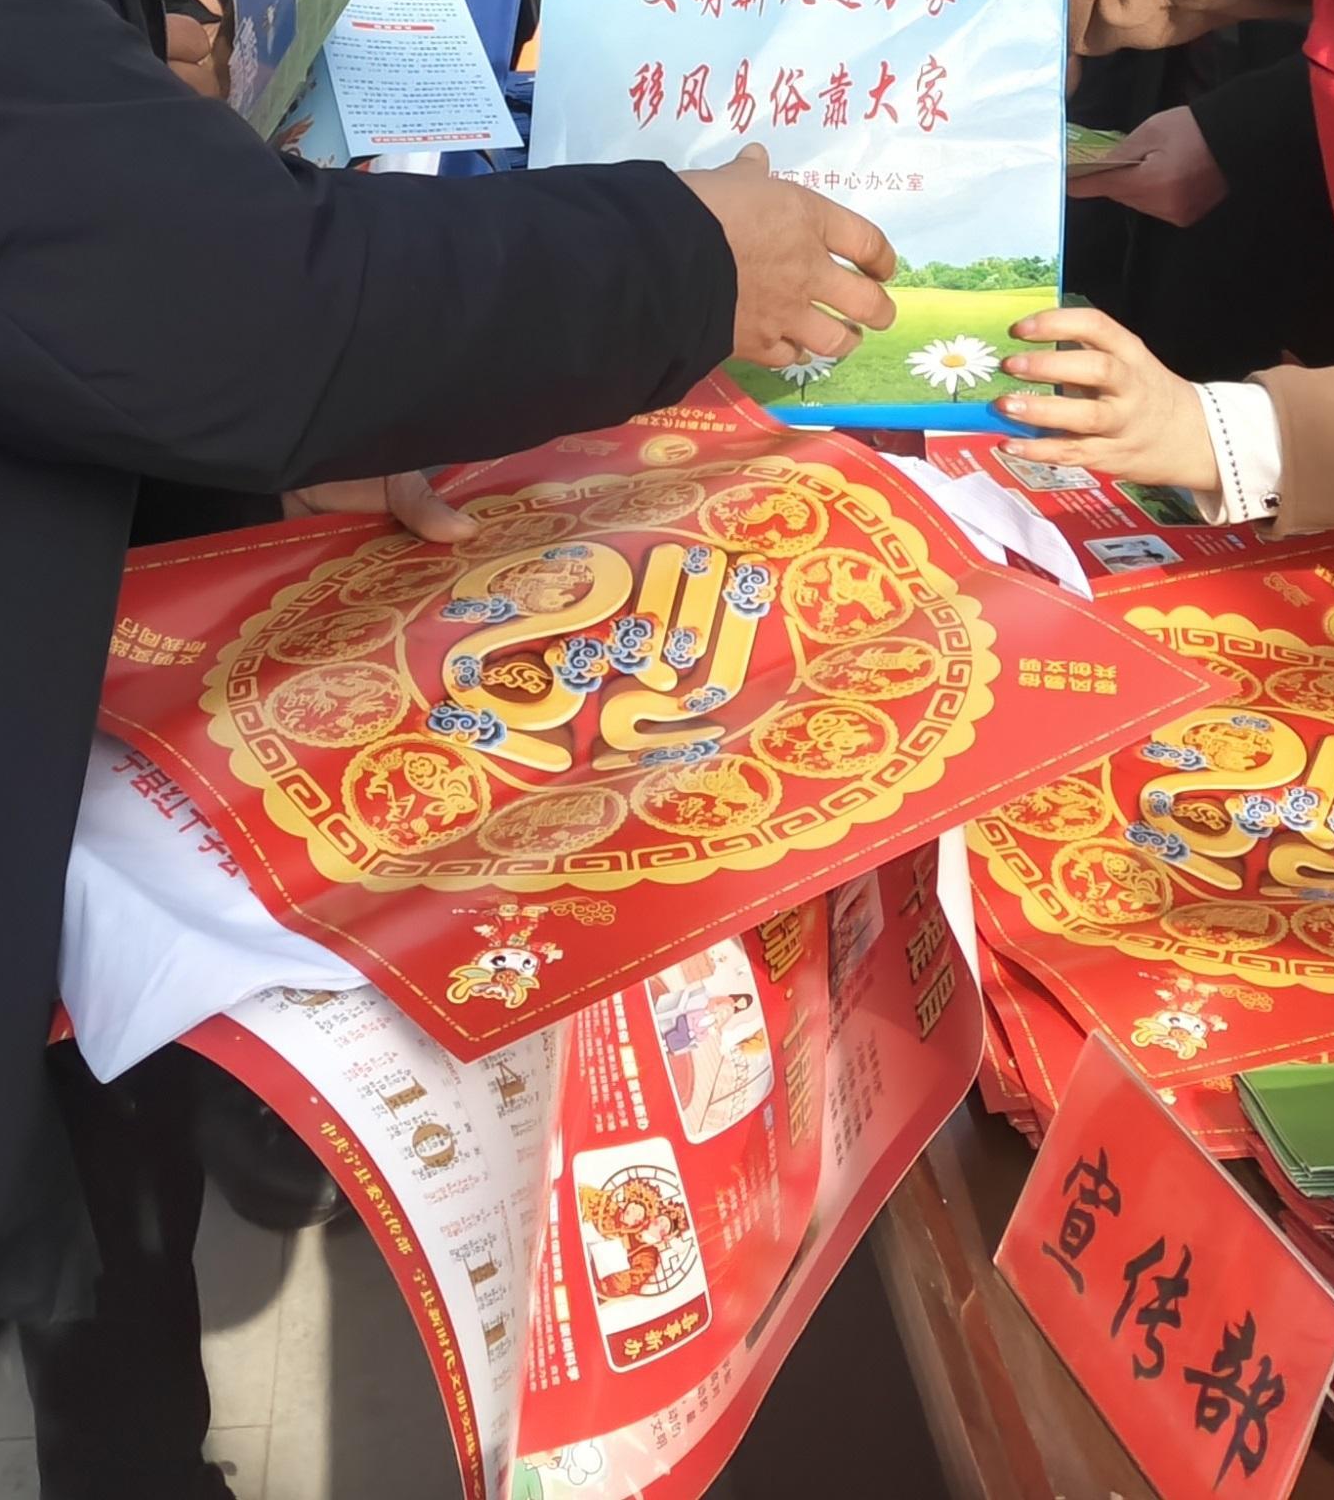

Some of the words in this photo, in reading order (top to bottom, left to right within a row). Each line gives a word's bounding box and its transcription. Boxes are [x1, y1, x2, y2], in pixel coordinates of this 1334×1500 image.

[627, 55, 951, 134] 移风易俗靠大家
[107, 635, 199, 669] 文明实践
[115, 615, 207, 656] 你我同行
[1017, 672, 1118, 696] 移风易俗
[1018, 656, 1117, 680] 共创文明
[320, 1119, 414, 1257] 中共宁县委宣传部
[1041, 1146, 1288, 1491] 宣传部
